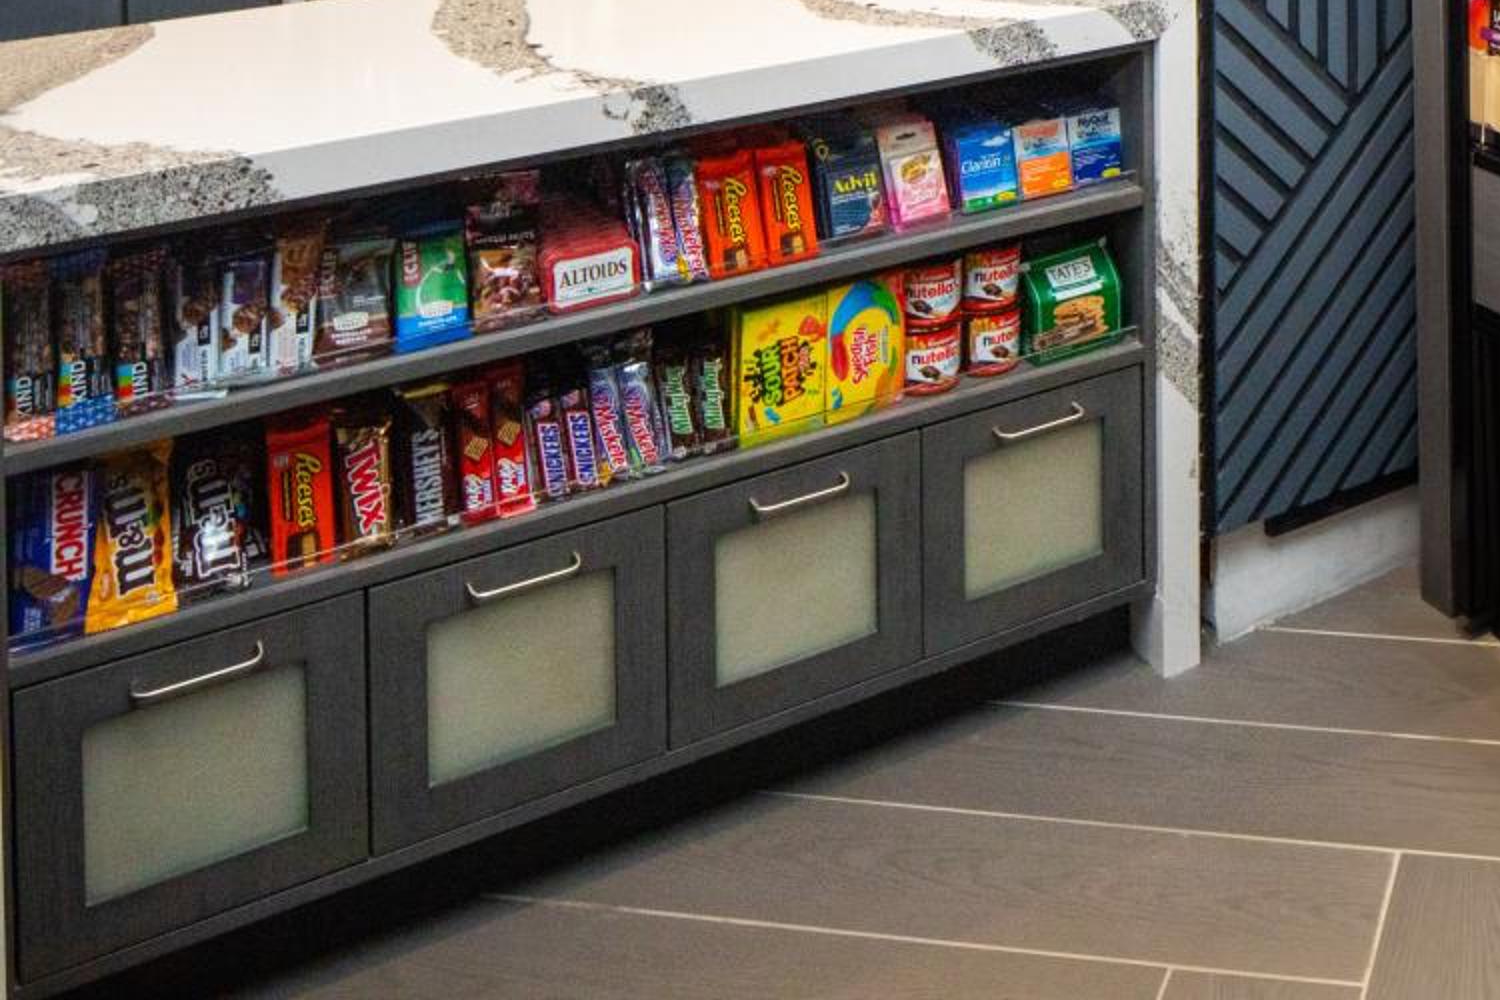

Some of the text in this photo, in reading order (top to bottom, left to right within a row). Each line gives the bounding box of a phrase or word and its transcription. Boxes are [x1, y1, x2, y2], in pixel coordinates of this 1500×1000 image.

[833, 170, 878, 195] Advil
[560, 258, 628, 289] ALTOIDS
[70, 359, 87, 402] KIND
[761, 345, 782, 406] SOUR
[781, 336, 800, 402] PATCH
[570, 413, 595, 484] SNICKERS
[53, 474, 87, 580] CRUNCH
